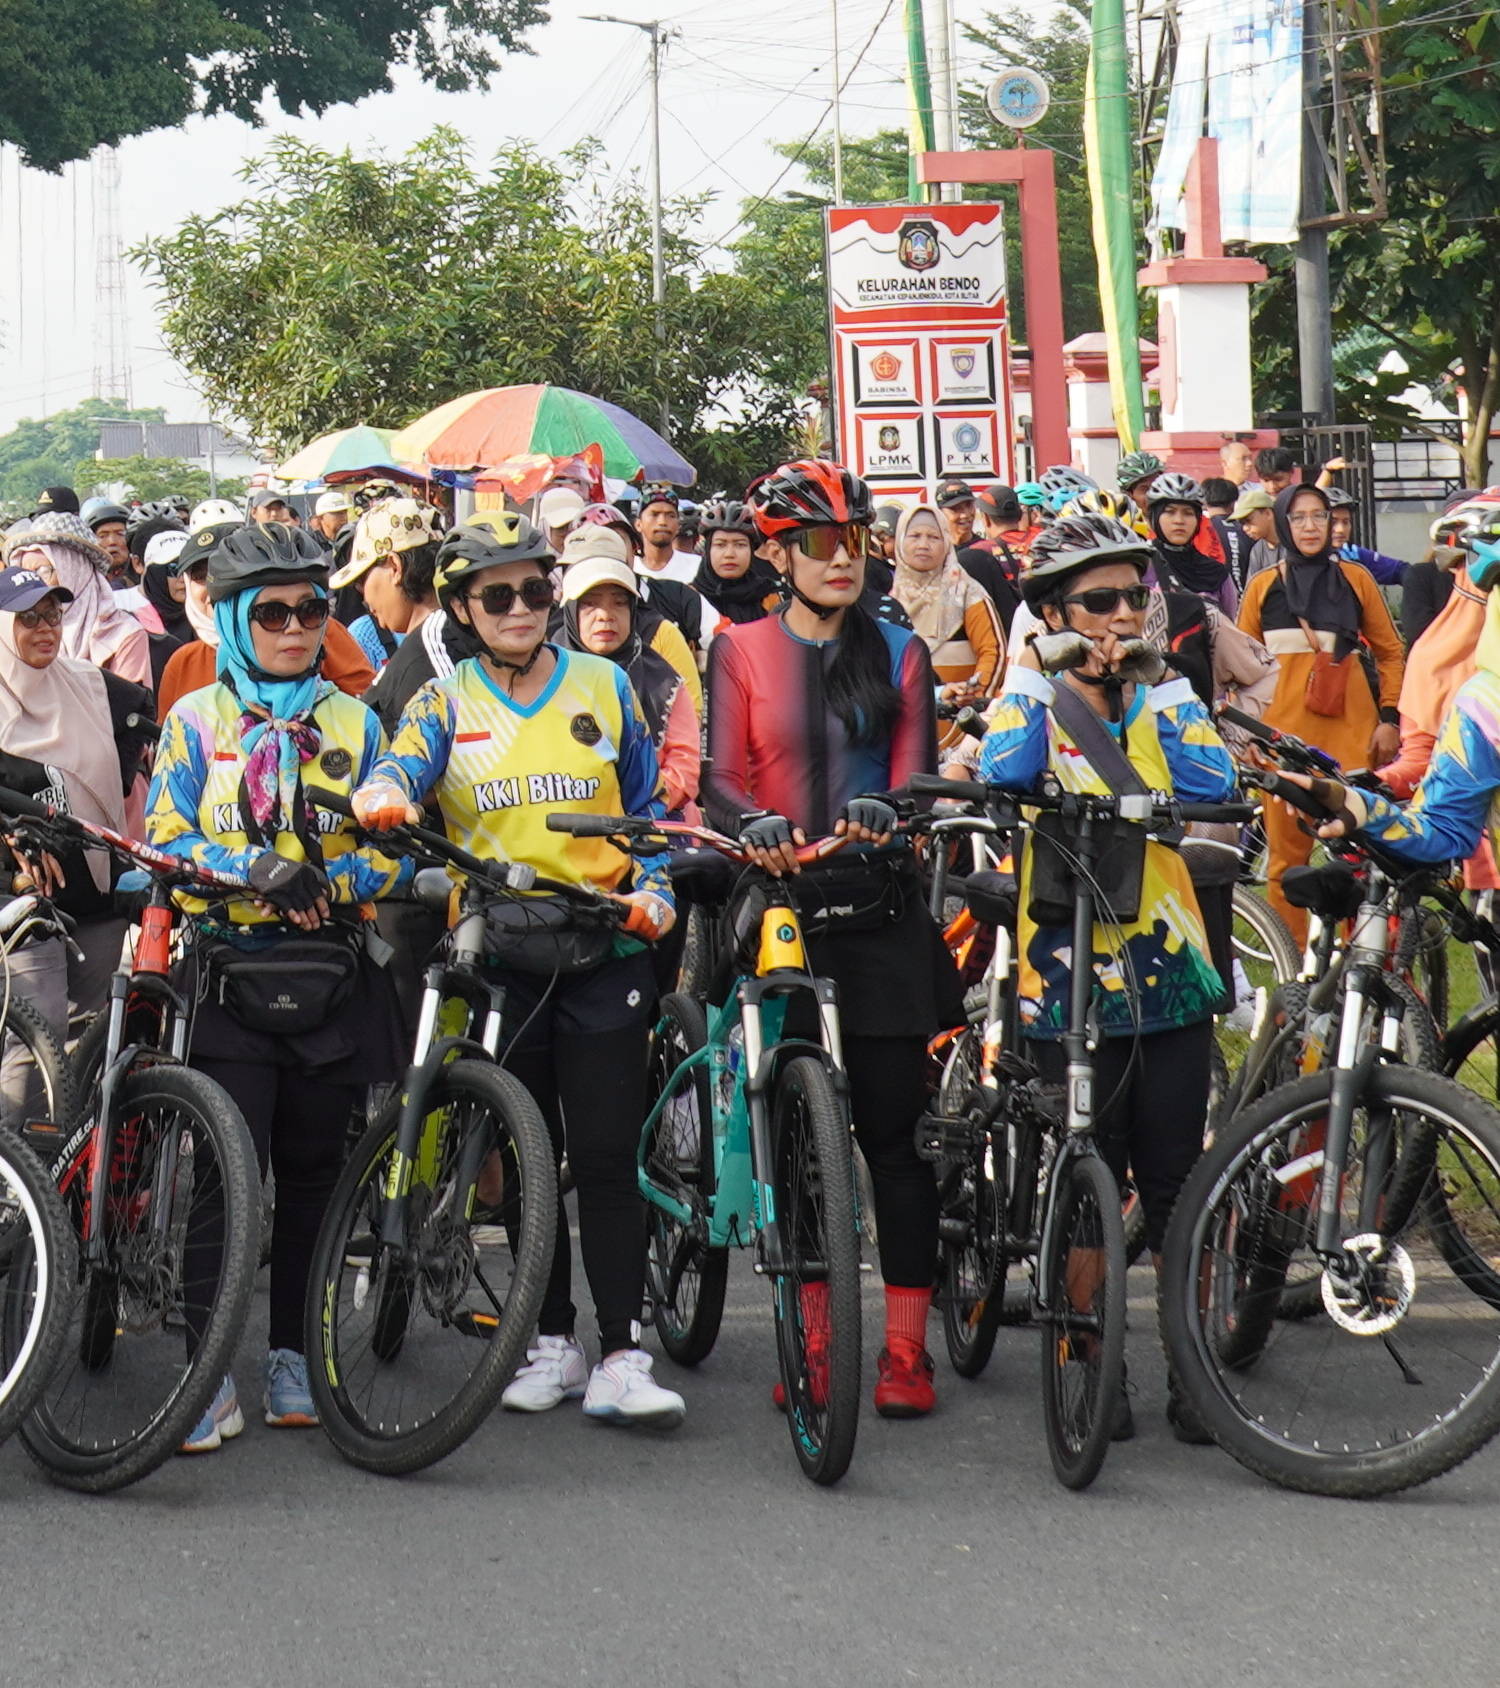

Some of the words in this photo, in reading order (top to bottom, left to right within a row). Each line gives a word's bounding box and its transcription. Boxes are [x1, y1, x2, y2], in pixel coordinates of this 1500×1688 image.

[857, 277, 936, 293] KELURAHAN
[939, 276, 980, 291] BENDO
[868, 386, 908, 394] BABINSA
[869, 454, 911, 466] LPMK
[474, 776, 522, 813] KKI
[527, 772, 600, 805] Blitar
